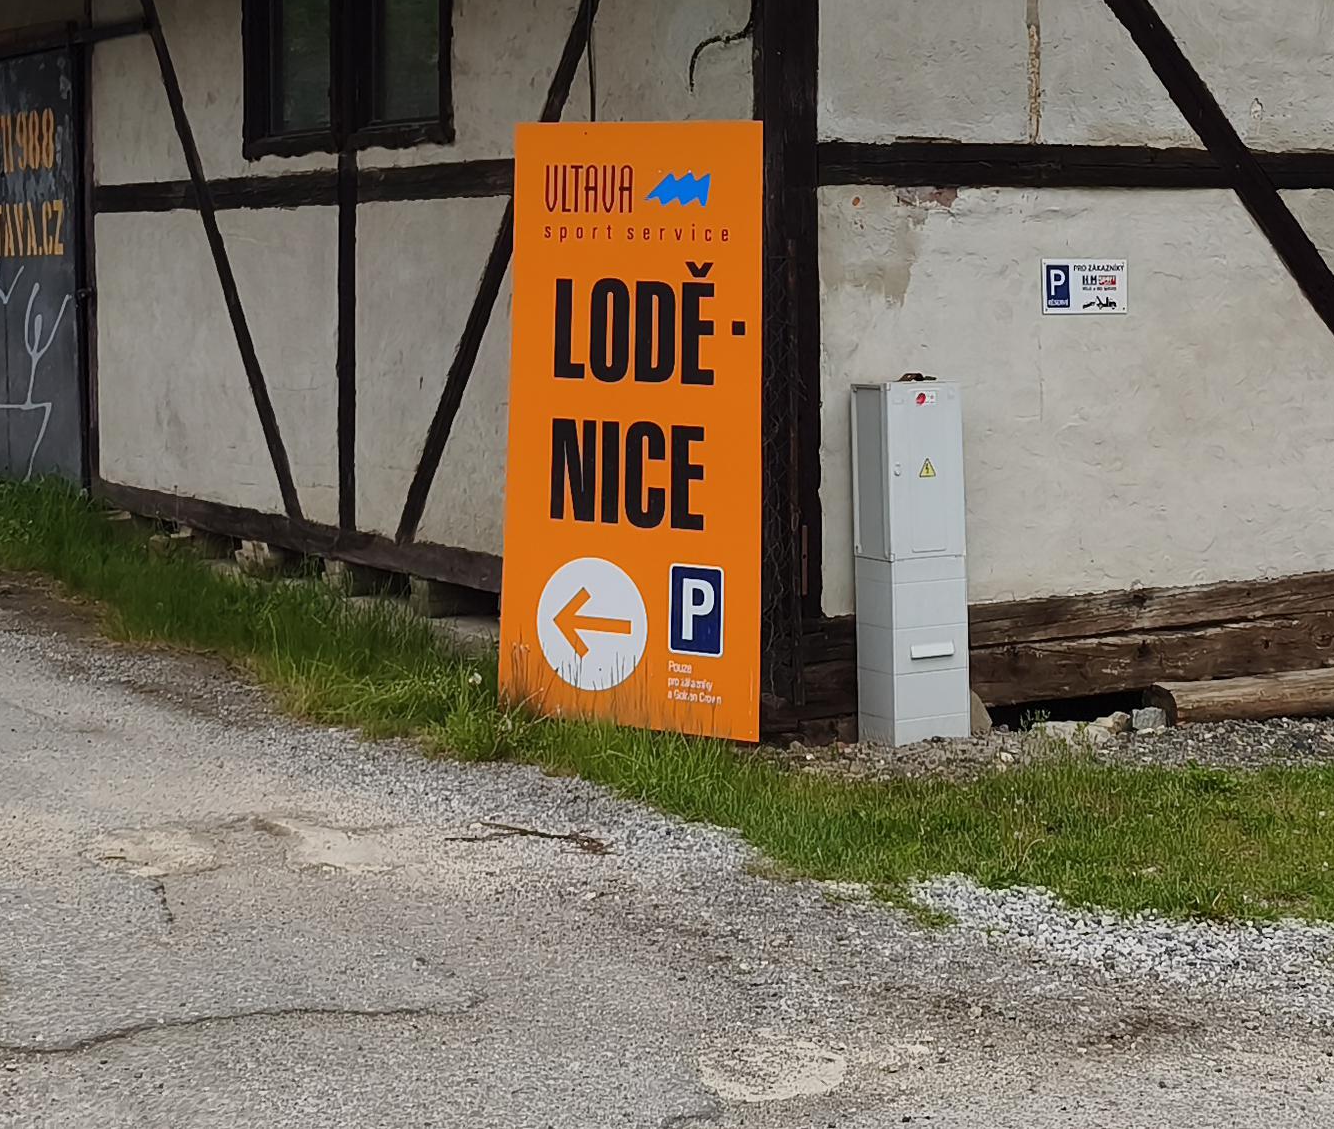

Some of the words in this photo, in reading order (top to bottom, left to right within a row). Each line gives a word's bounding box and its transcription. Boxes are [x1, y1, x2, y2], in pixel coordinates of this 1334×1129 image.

[16, 107, 54, 170] 988
[545, 165, 634, 213] VLTAVA
[544, 225, 612, 242] sport
[627, 224, 729, 242] service
[1049, 269, 1066, 296] P
[549, 418, 705, 531] NICE
[681, 578, 716, 641] P
